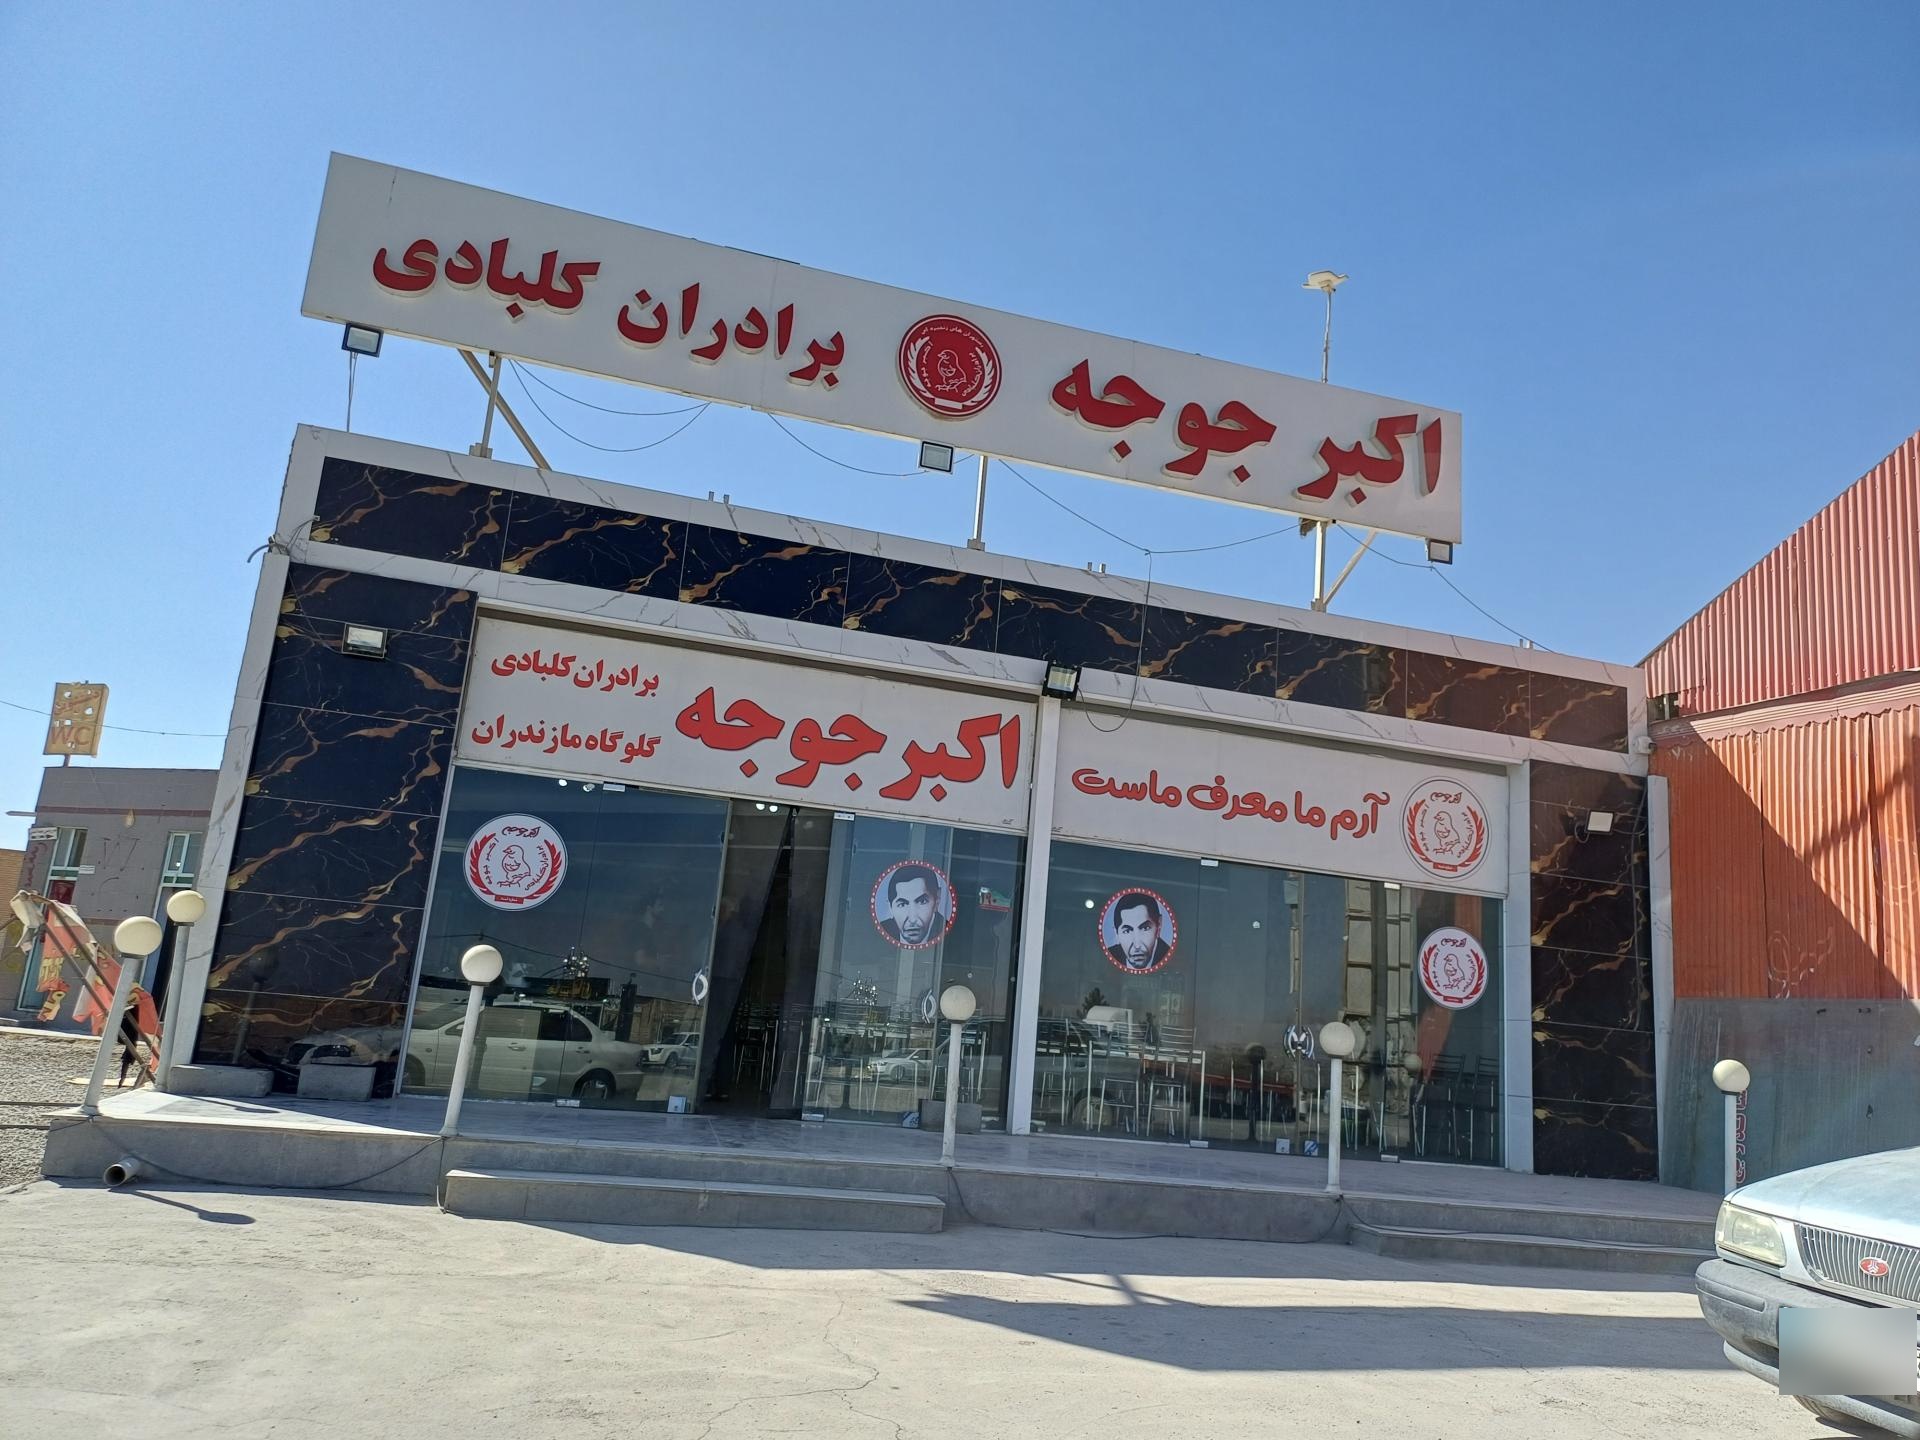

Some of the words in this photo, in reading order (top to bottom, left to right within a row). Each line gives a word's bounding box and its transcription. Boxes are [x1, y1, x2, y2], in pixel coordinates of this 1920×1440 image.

[373, 238, 601, 321] کلبادی
[617, 282, 845, 389] برادران
[1051, 358, 1277, 484] جوجه
[1295, 413, 1442, 504] اکبر
[490, 648, 577, 678] کلبادی
[573, 659, 660, 698] برادران
[50, 725, 91, 746] WC
[471, 714, 582, 755] مازندران
[585, 725, 661, 764] گلوگاه
[675, 686, 887, 791] جوجه
[879, 713, 1020, 801] اکبر
[1071, 767, 1182, 808] ماست
[1186, 774, 1289, 822] معرف
[1293, 790, 1327, 828] ما
[1330, 791, 1390, 840] آرم
